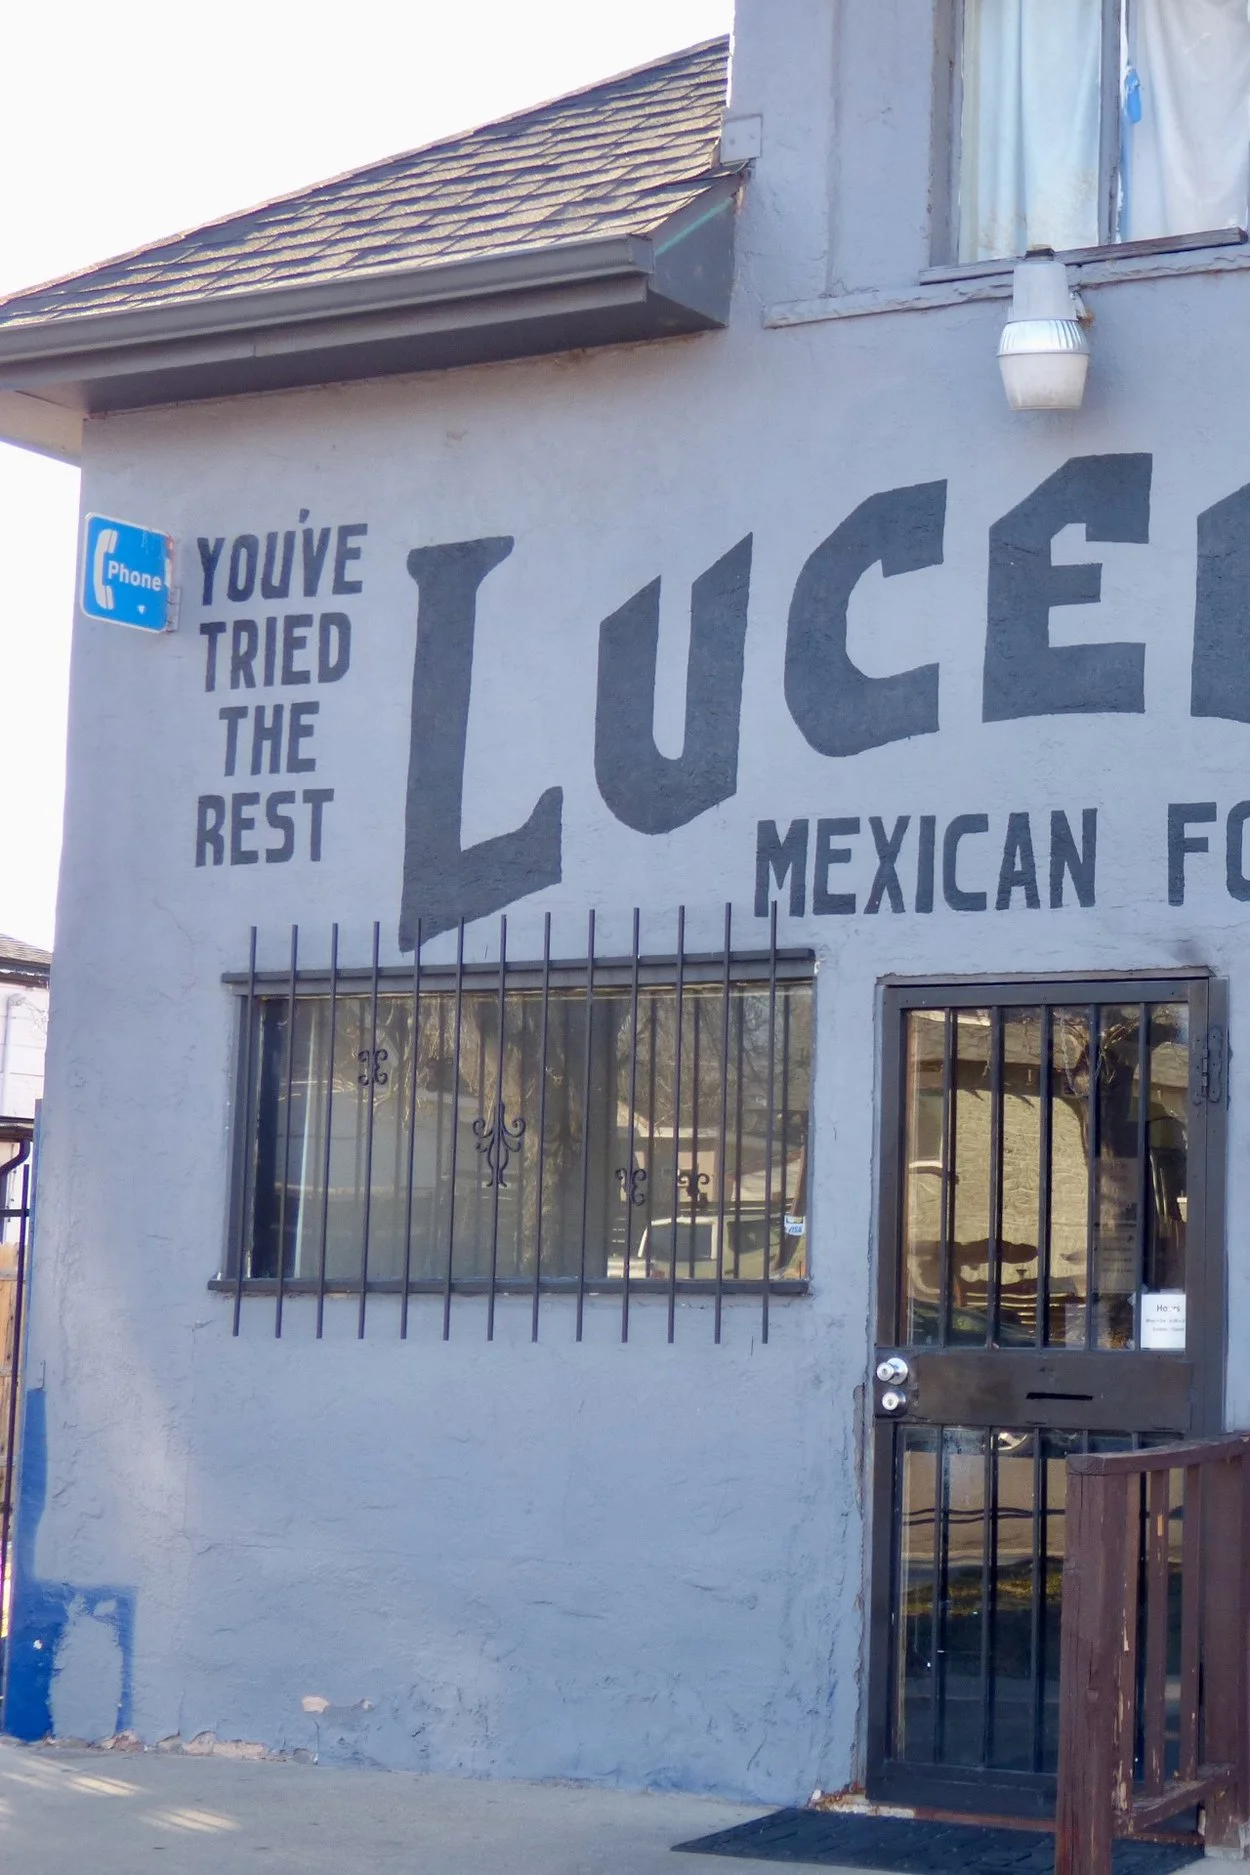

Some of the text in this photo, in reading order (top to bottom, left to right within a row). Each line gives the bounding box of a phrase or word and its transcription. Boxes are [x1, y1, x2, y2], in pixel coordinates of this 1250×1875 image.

[108, 560, 162, 591] Phone
[197, 509, 368, 606] YOU'VE
[199, 612, 351, 692] TRIED
[219, 701, 320, 776] THE
[195, 789, 334, 867] REST
[754, 808, 1098, 918] MEXICAN
[1156, 1304, 1181, 1312] Hors
